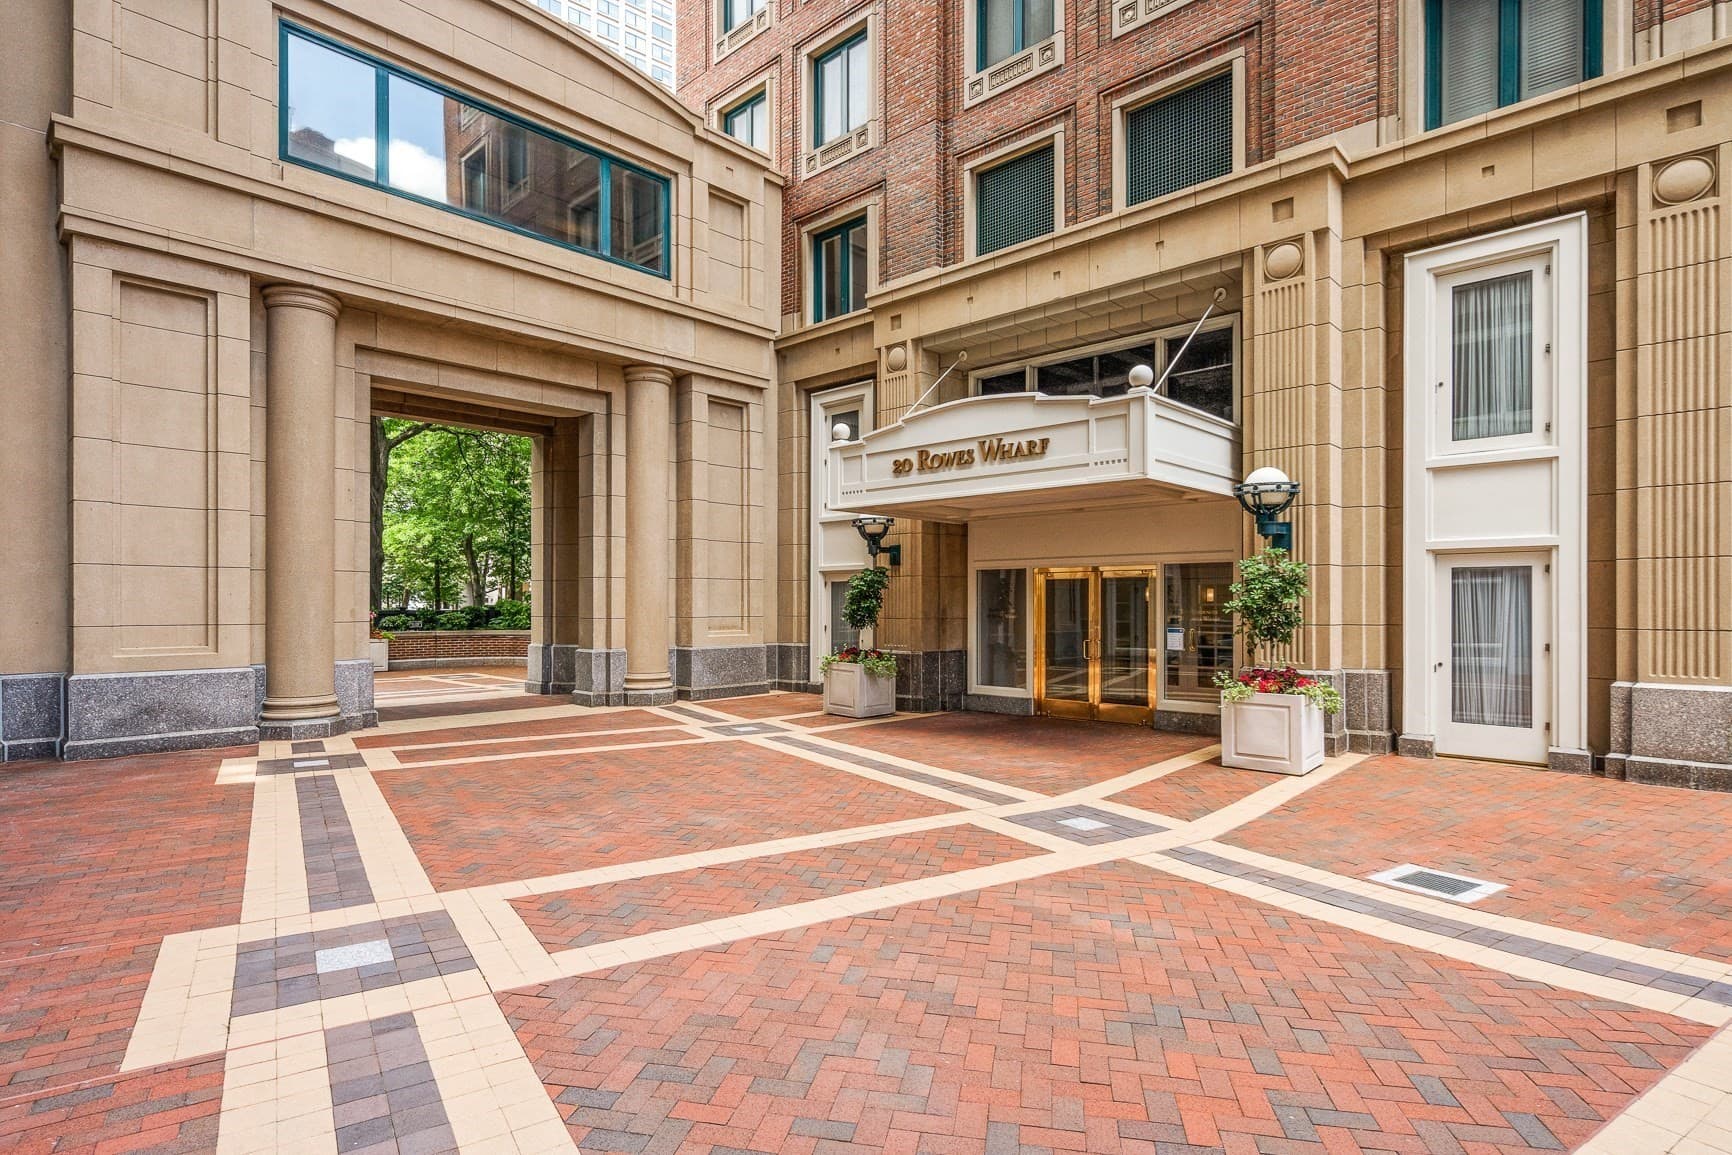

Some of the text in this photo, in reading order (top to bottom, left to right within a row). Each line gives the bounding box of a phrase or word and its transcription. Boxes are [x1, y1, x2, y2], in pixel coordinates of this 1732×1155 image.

[892, 437, 1050, 474] 20 ROWES WHARF
